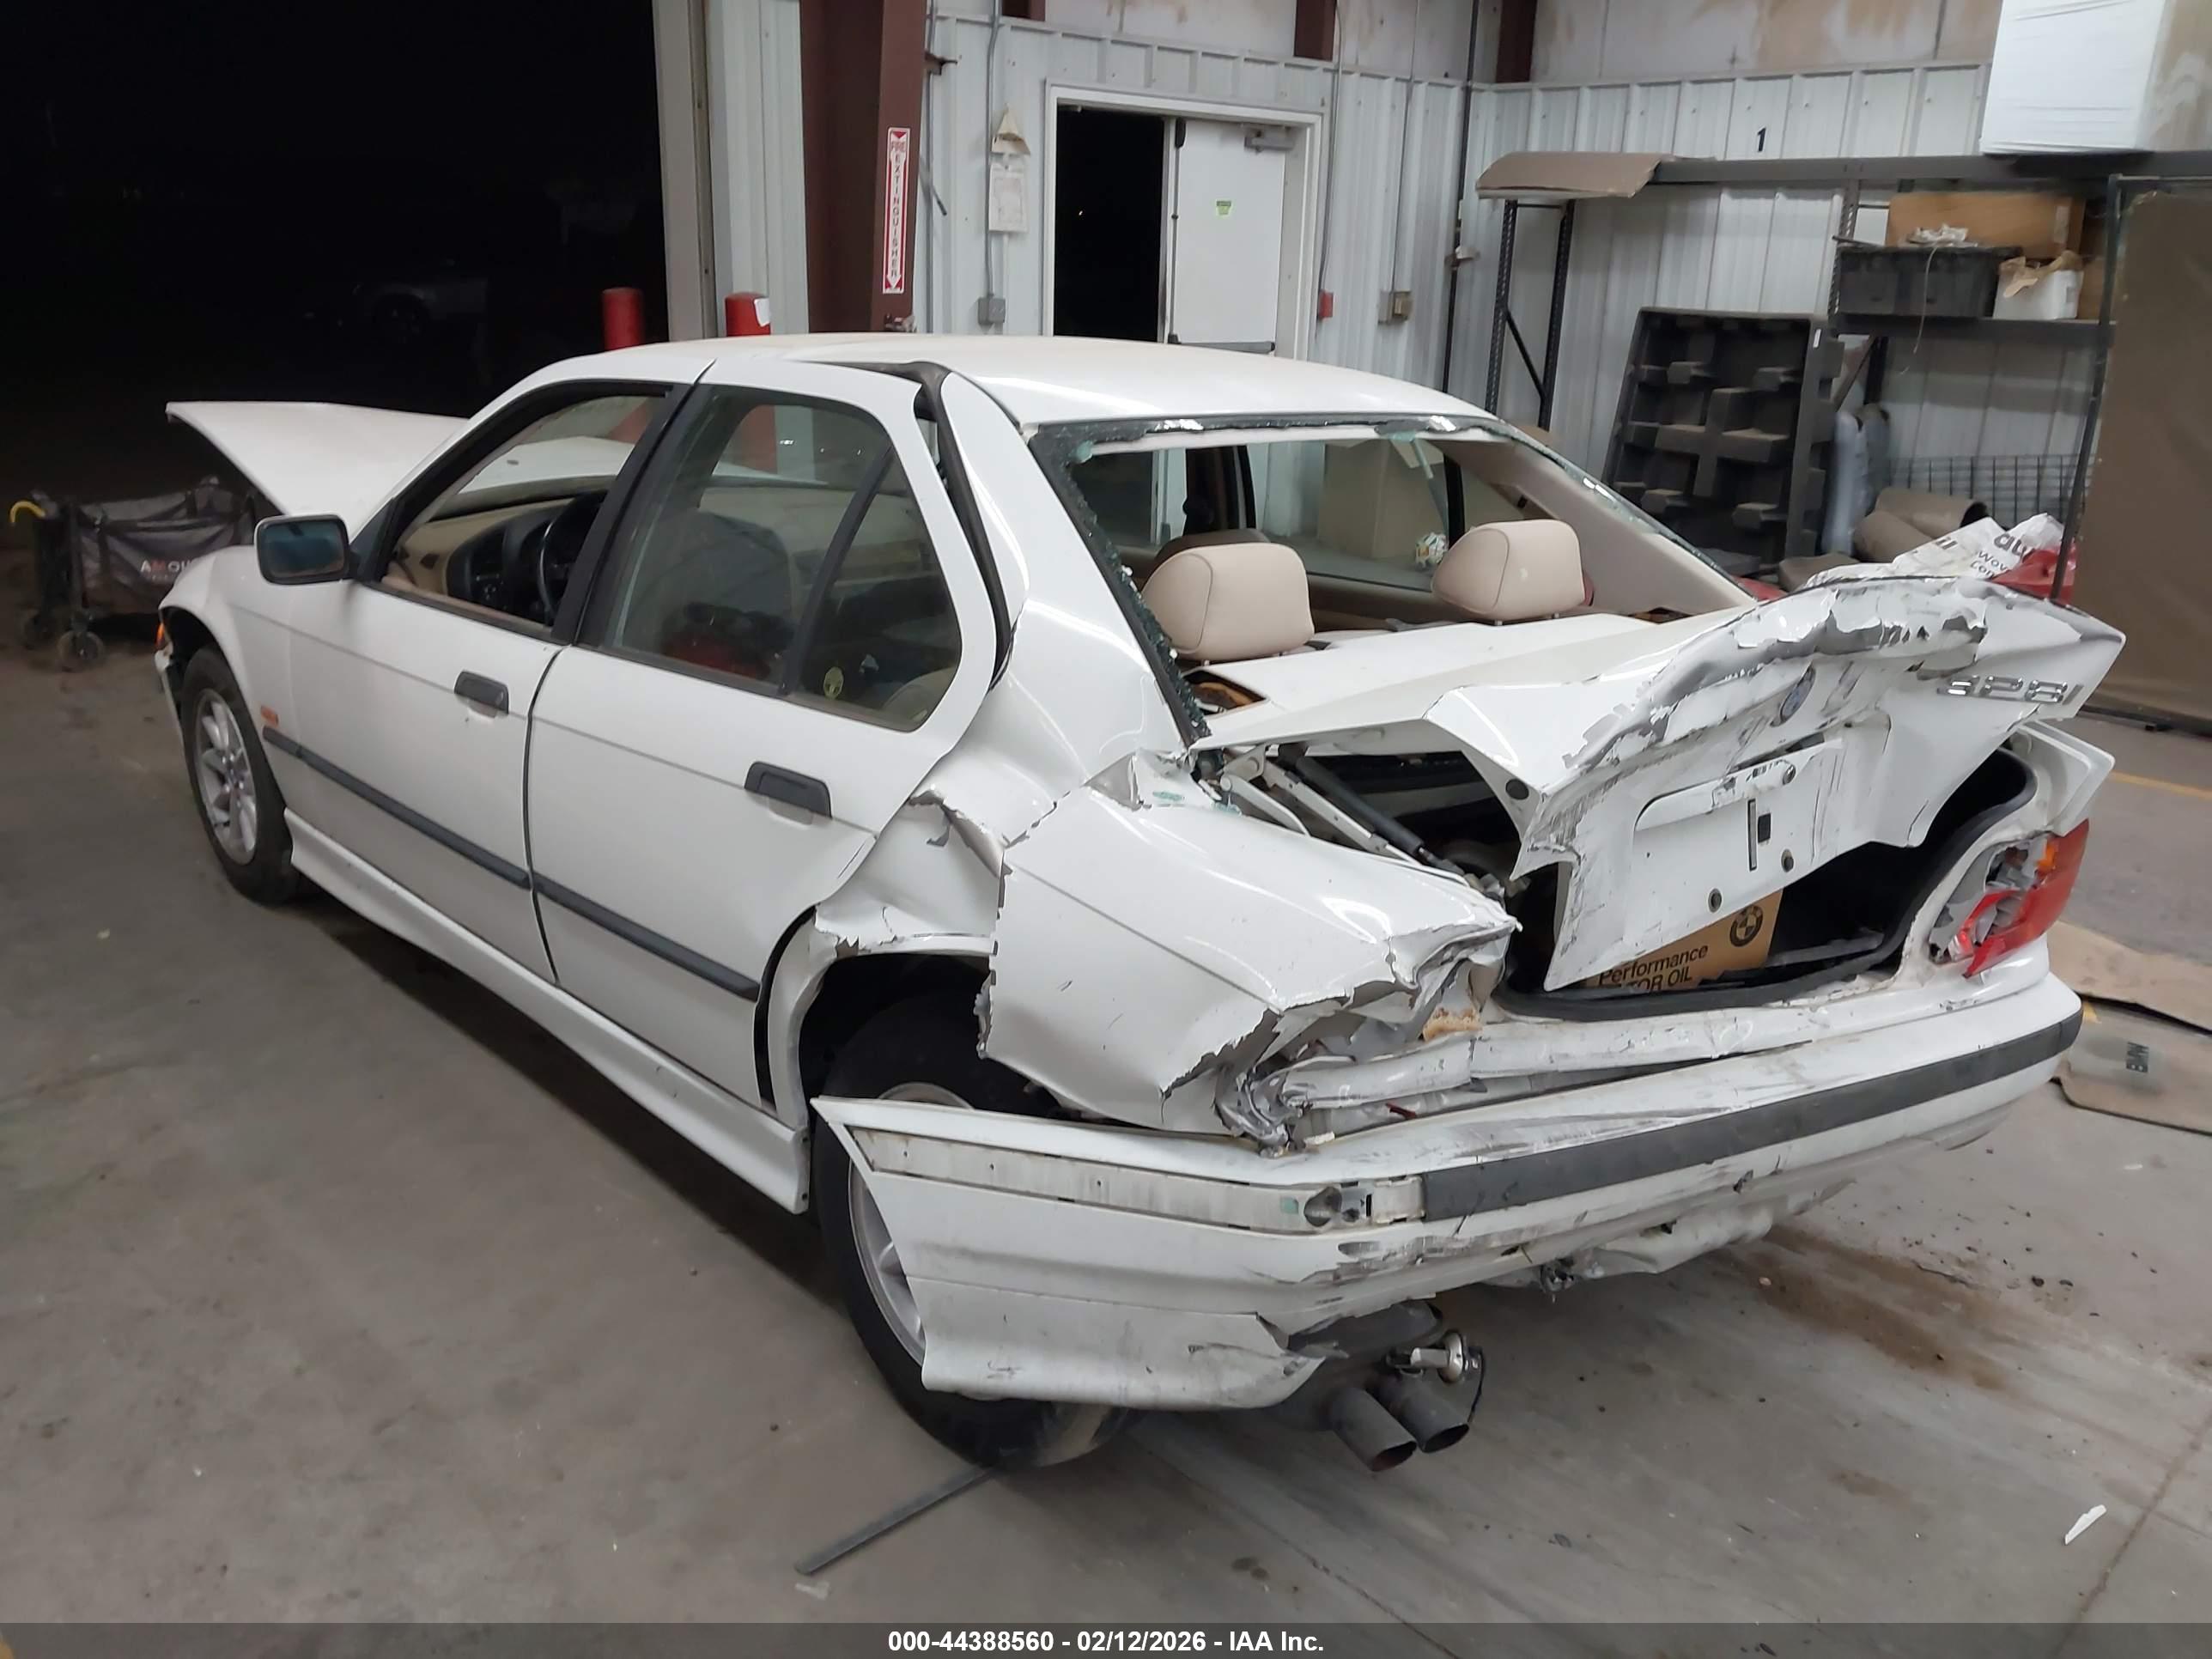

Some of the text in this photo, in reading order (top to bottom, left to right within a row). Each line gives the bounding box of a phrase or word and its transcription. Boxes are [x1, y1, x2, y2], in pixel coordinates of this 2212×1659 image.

[1757, 127, 1765, 152] 1
[1598, 945, 1709, 987] Performance
[1668, 967, 1692, 987] OIL
